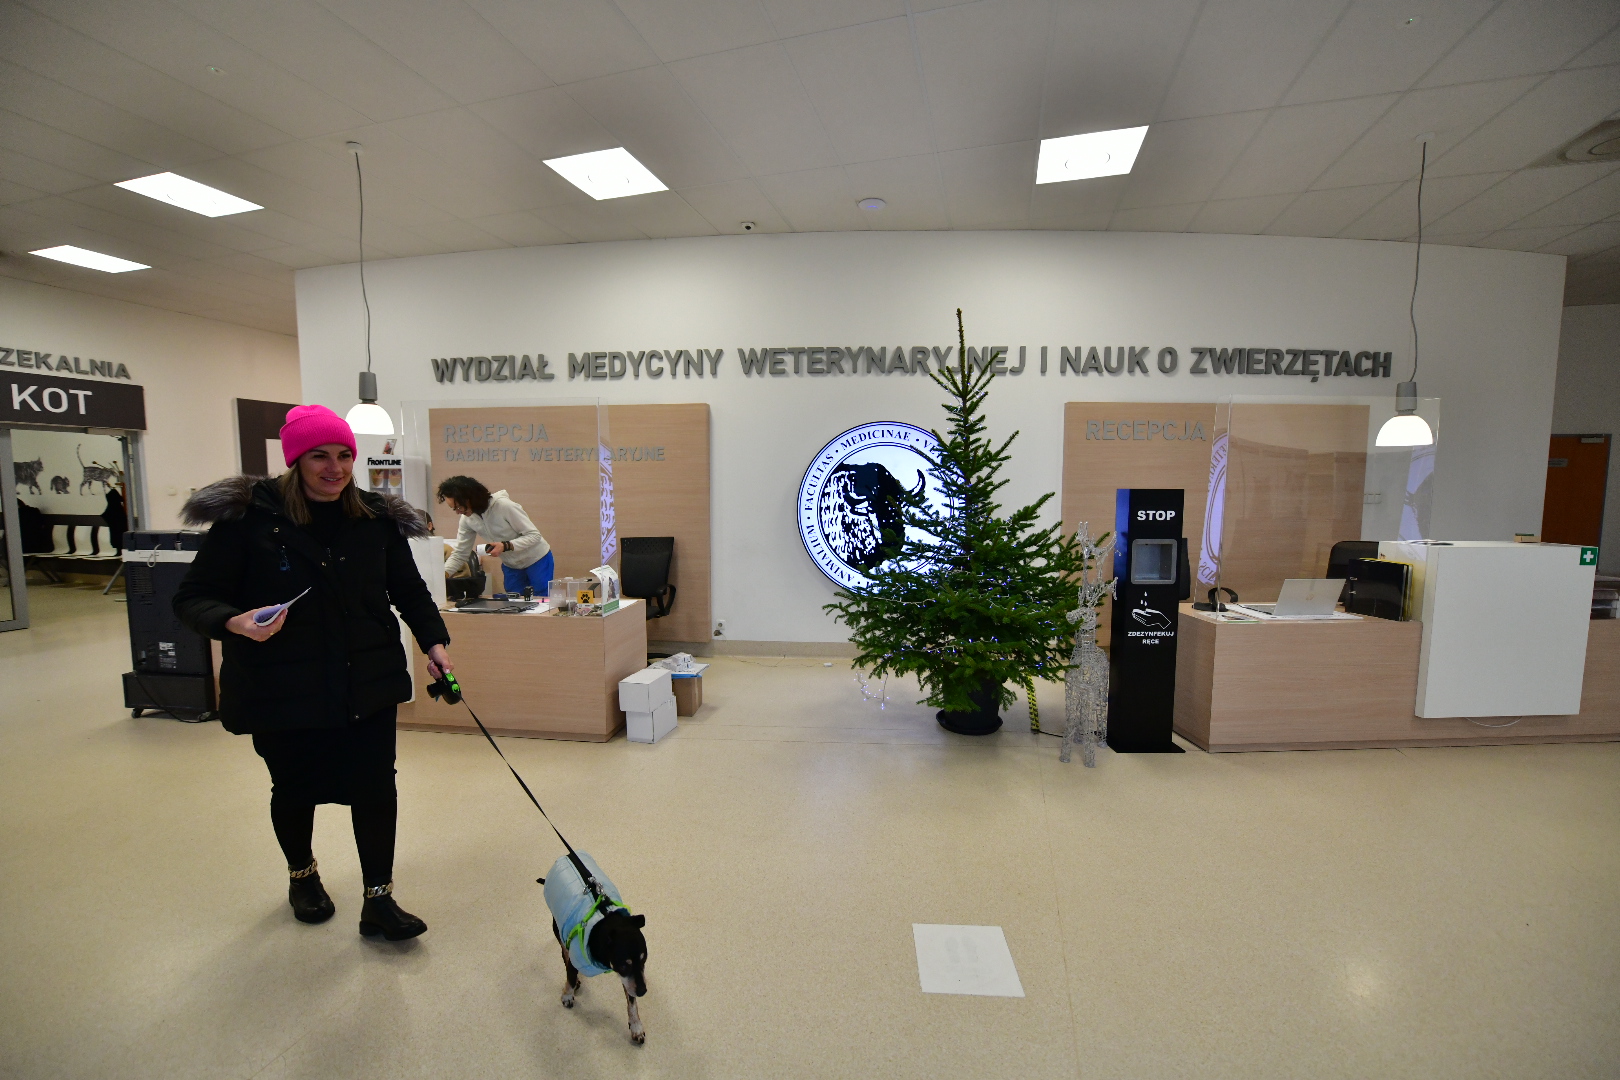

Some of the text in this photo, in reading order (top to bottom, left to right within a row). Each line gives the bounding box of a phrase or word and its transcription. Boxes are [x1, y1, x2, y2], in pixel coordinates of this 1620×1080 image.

[0, 346, 132, 380] ZEKALNIA
[431, 353, 555, 383] WYDZIAŁ
[568, 348, 724, 379] MEDYCYNY
[1040, 345, 1048, 374] I
[1059, 345, 1150, 374] NAUK
[1157, 346, 1178, 374] O
[1189, 346, 1392, 382] ZWIERZĘTACH
[11, 383, 93, 415] KOT
[443, 423, 549, 443] RECEPCJA
[841, 429, 911, 451] MEDICINAE
[1086, 419, 1207, 442] RECEPCJA
[445, 446, 666, 462] GABINETY WETERYARYJNE
[804, 453, 835, 511] FACULTAS
[1136, 510, 1176, 521] STOP
[806, 525, 855, 583] ANIMALIUM
